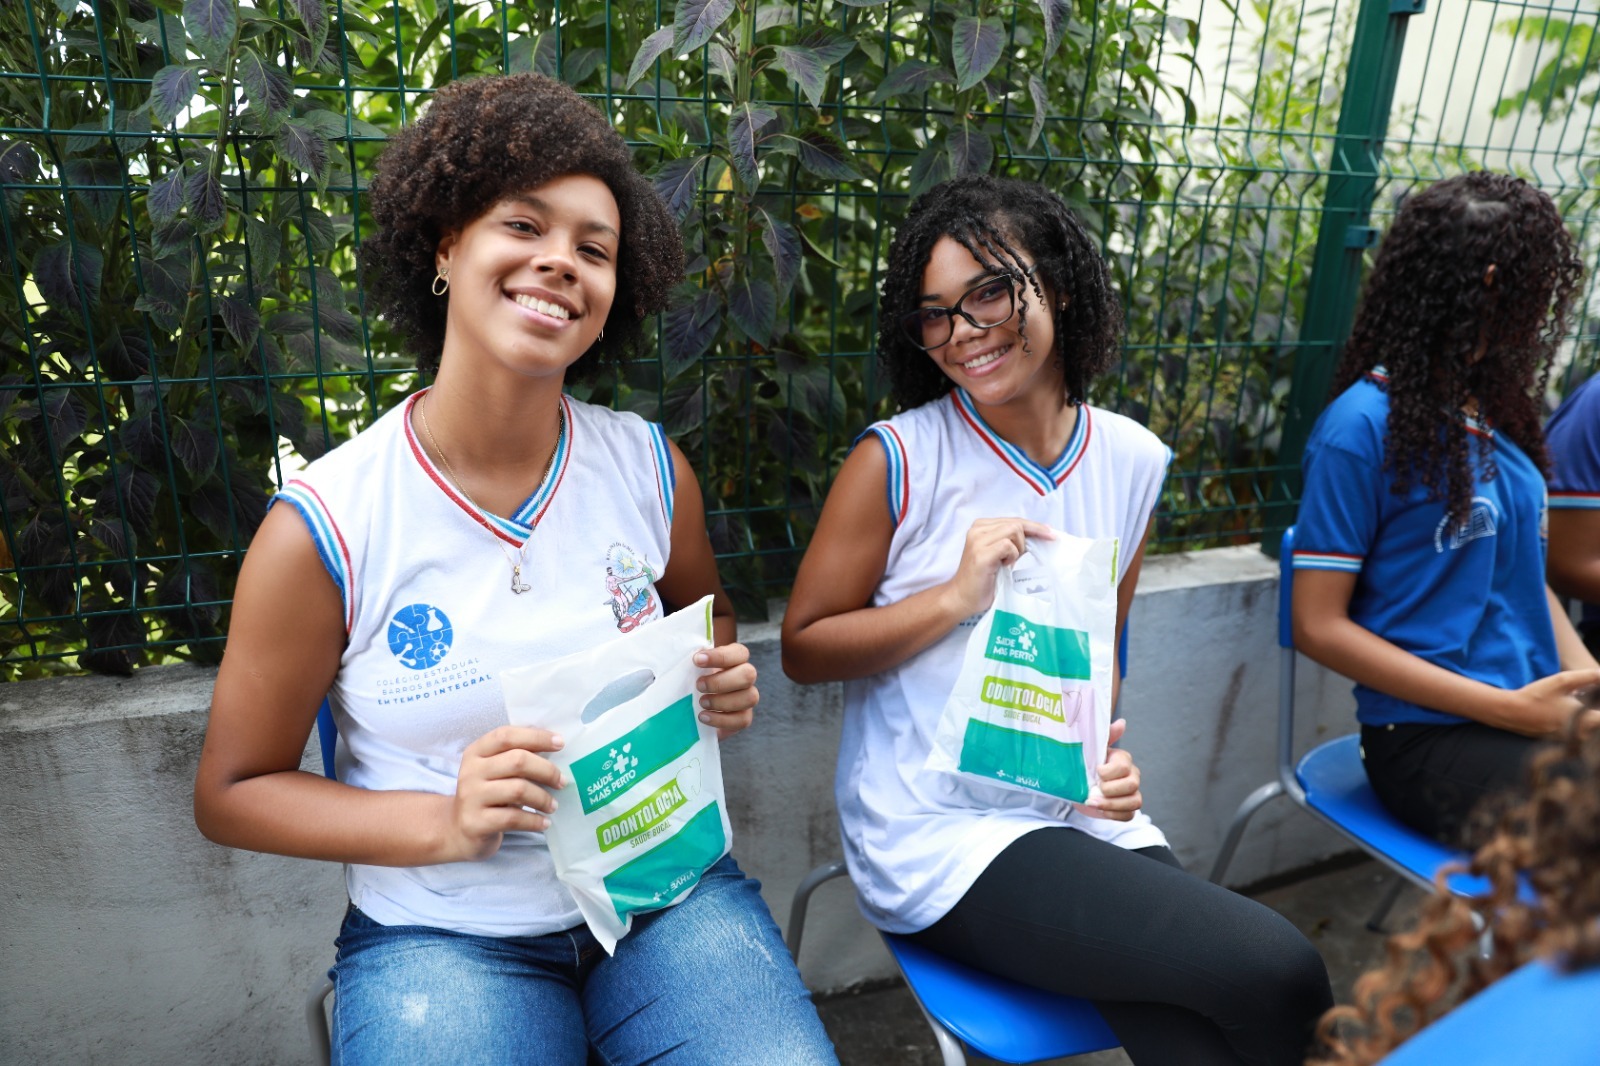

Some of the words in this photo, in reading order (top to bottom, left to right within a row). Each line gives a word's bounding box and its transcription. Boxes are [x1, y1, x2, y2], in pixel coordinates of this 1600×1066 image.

[424, 657, 480, 679] ESTADUAL
[1009, 648, 1035, 662] PERTO
[382, 683, 423, 695] BARROS
[426, 668, 477, 688] BARRETO
[393, 692, 430, 704] TEMPO
[434, 674, 492, 696] INTEGRAL
[985, 681, 1062, 717] ODONTOLOGIA
[587, 772, 614, 795] SAÚDE
[589, 786, 611, 805] MAIS
[611, 769, 636, 792] PERTO
[602, 784, 683, 846] ODONTOLOGIA
[652, 819, 671, 837] BUCAL
